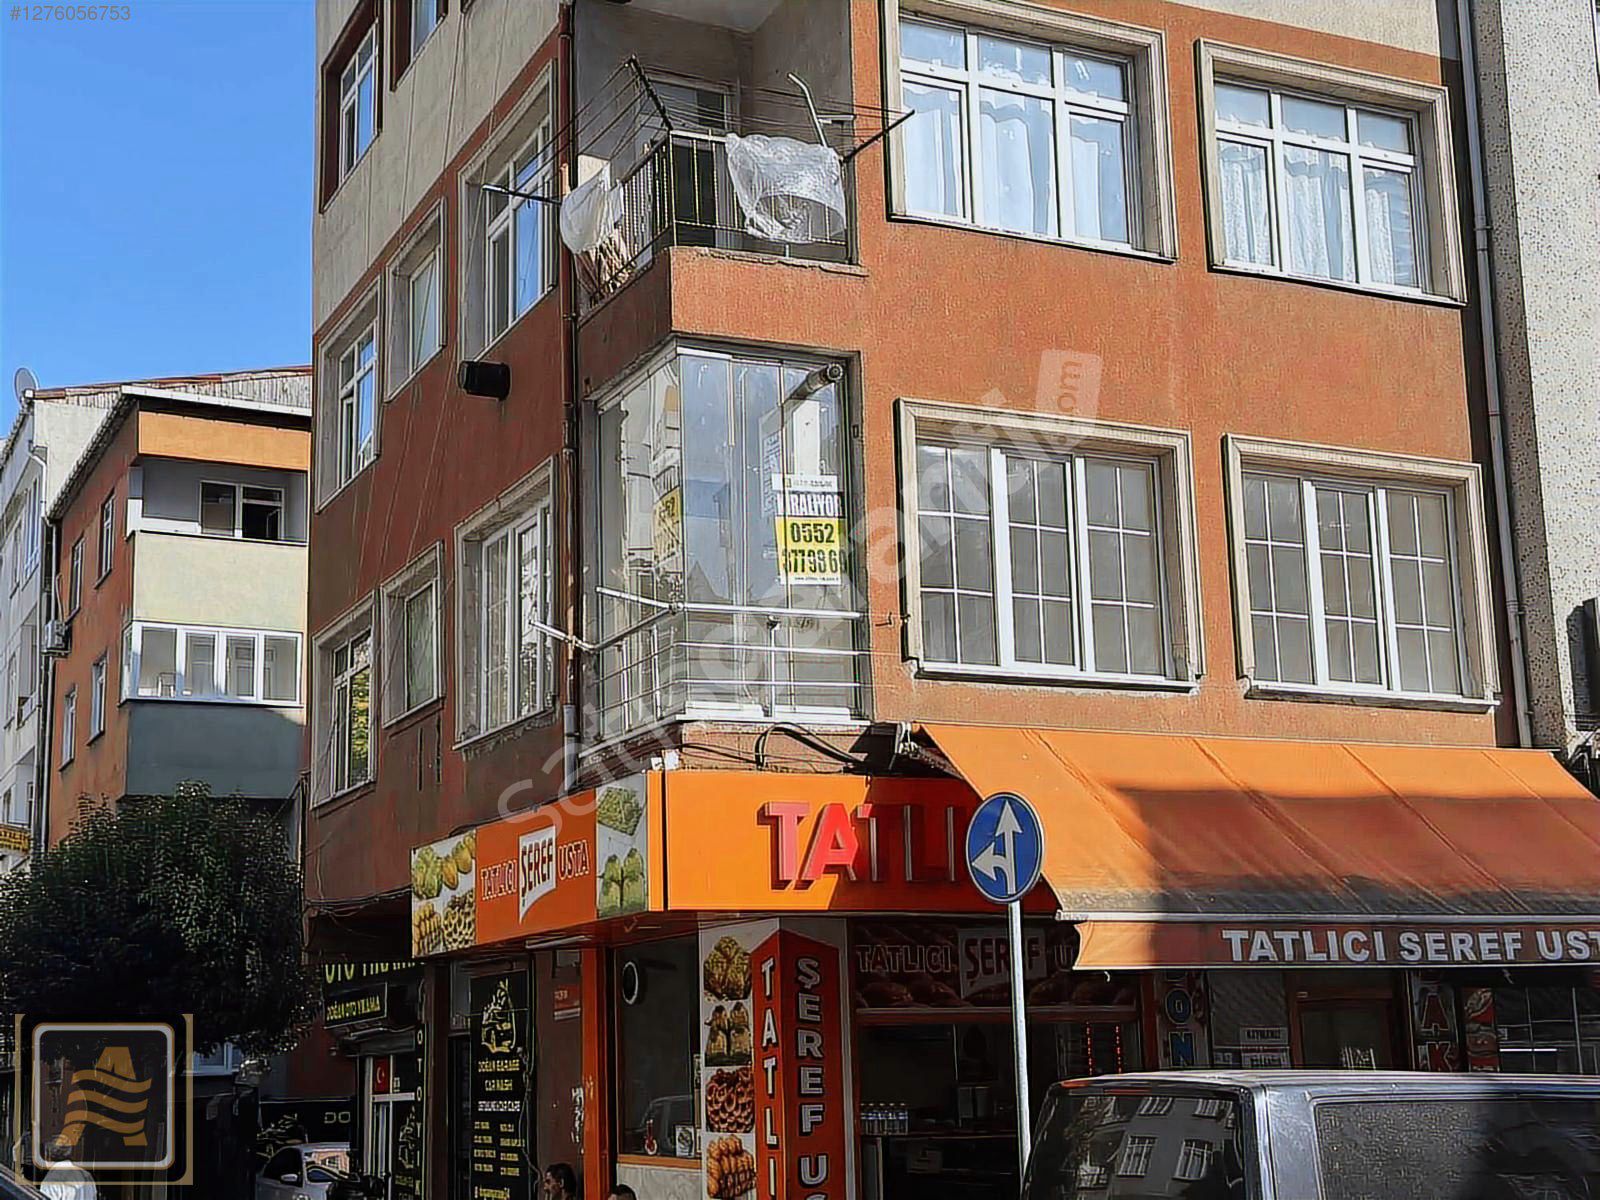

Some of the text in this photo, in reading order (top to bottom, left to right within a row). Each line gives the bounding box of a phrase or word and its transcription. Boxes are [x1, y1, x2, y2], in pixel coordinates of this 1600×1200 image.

[790, 522, 834, 543] 0552
[558, 839, 590, 882] USTA
[857, 944, 953, 974] TATLICI
[964, 936, 1040, 985] ŞERF
[1222, 929, 1385, 962] TATLICI
[1399, 931, 1523, 962] SEREF
[796, 957, 824, 1134] ŞEREF
